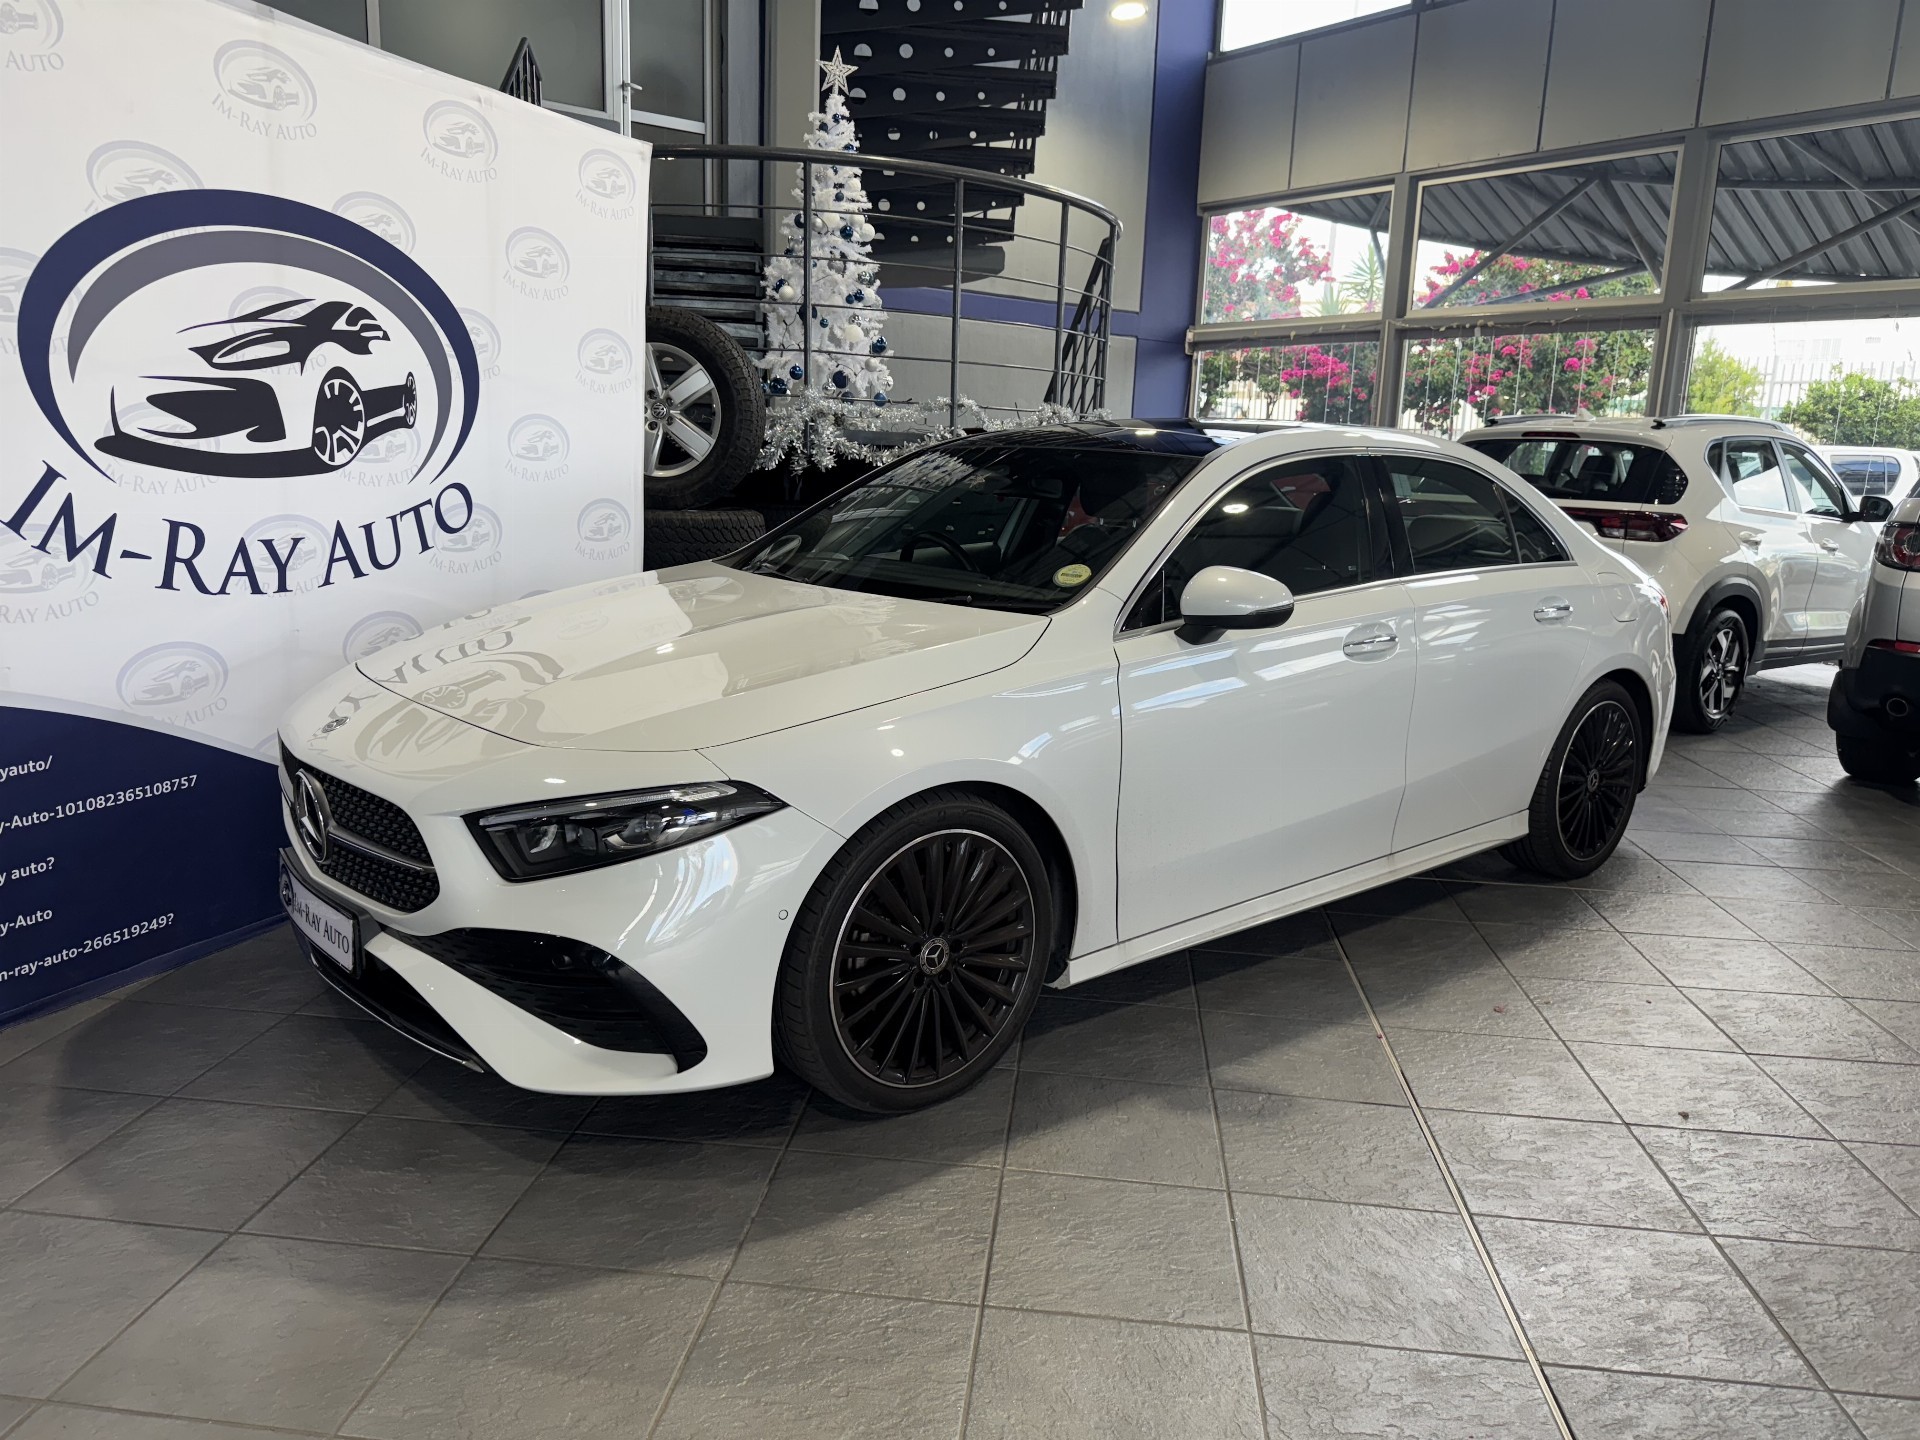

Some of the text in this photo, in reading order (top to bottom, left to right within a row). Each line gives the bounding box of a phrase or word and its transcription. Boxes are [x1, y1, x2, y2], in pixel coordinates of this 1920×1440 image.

[5, 49, 65, 73] AUTO
[211, 93, 318, 141] IM-RAY AUTO
[420, 146, 498, 184] IM-RAY AUTO
[575, 189, 635, 221] IM-RAY AUTO
[502, 269, 569, 301] IM-RAY AUTO
[575, 369, 632, 395] IM-RAY AUTO
[504, 459, 569, 483] IM-RAY AUTO
[0, 460, 473, 596] IM-RAY AUTO
[428, 551, 502, 575] IM-RAY AUTO
[574, 540, 630, 561] IM-RAY AUTO
[44, 591, 100, 622] AUTO
[183, 697, 228, 727] AUTO
[11, 856, 55, 880] auto?
[323, 920, 350, 954] AUTO
